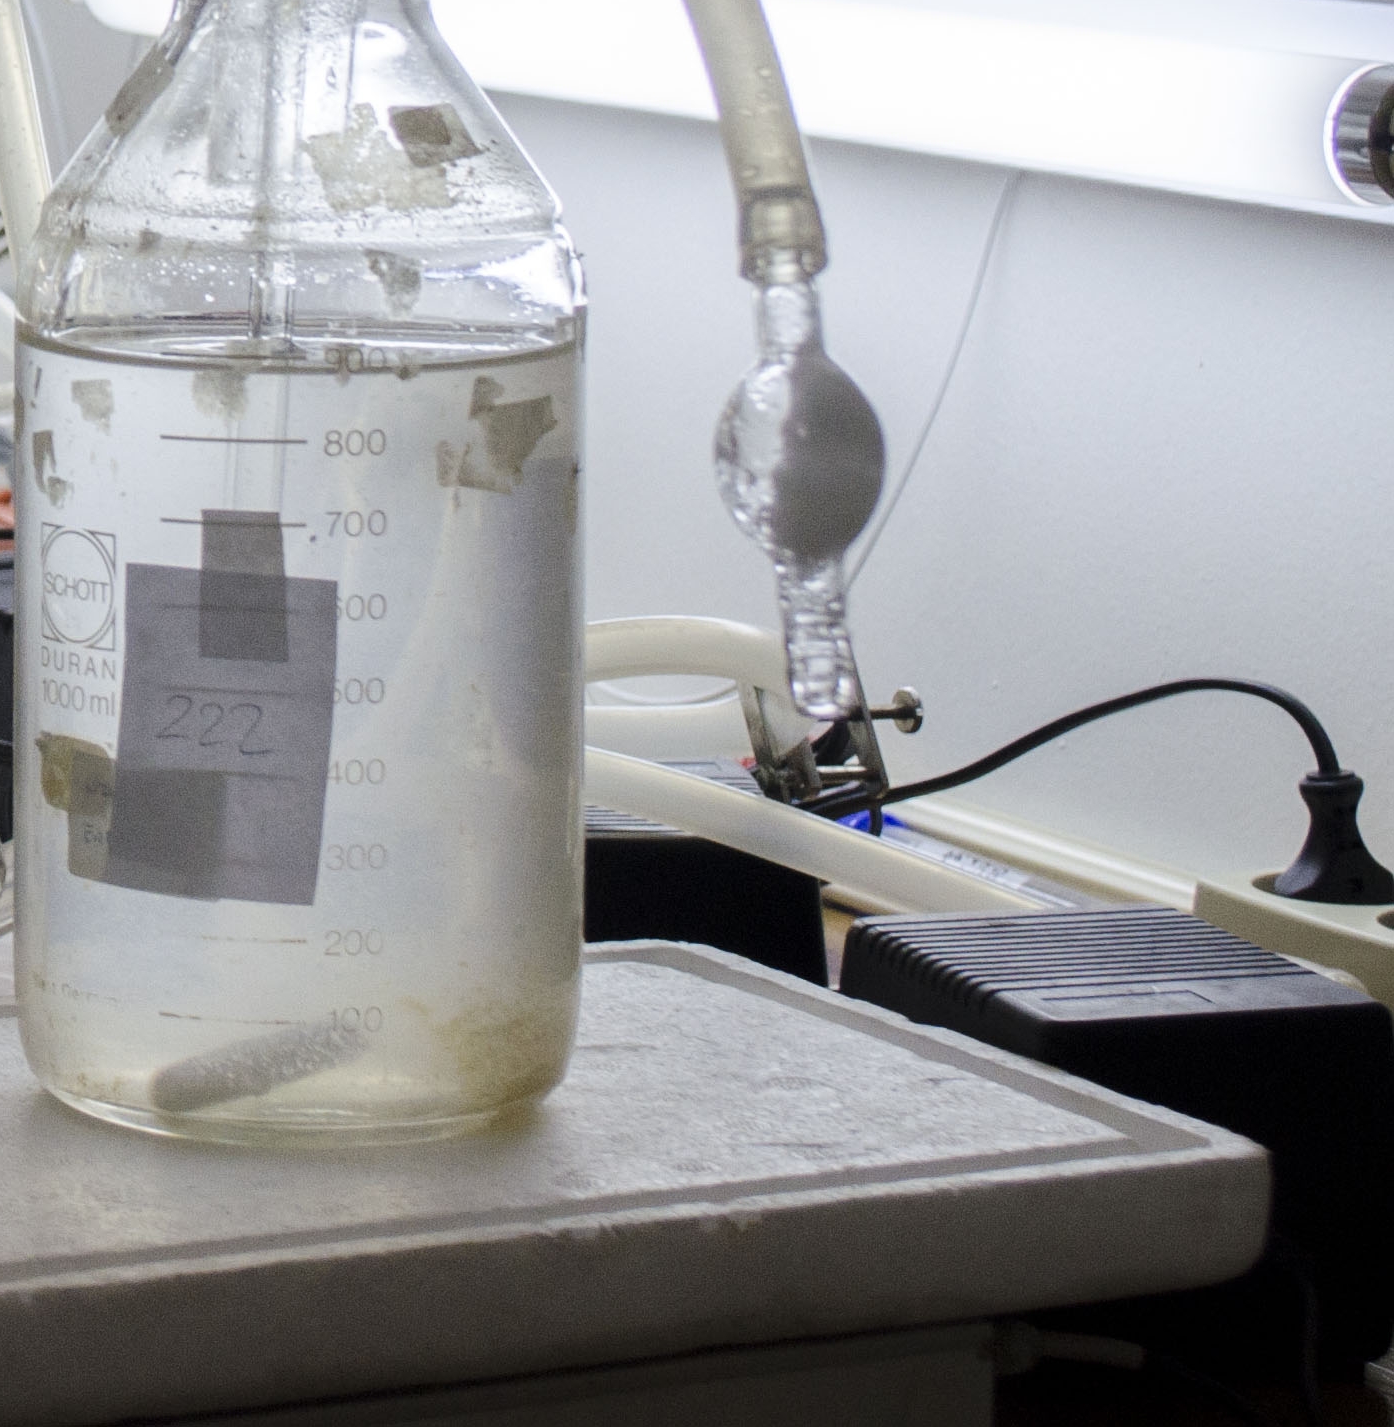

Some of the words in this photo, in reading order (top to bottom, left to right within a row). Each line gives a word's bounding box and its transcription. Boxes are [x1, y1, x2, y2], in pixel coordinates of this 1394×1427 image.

[324, 347, 387, 373] 900
[323, 428, 387, 457] 800
[325, 509, 387, 537] 700
[43, 571, 110, 604] SCHOTT
[40, 644, 116, 681] DURAN
[42, 678, 85, 712] 1000
[89, 691, 116, 717] ml
[153, 693, 279, 757] 222
[324, 843, 387, 871] 300
[323, 929, 384, 957] 200
[329, 1005, 384, 1033] 100
